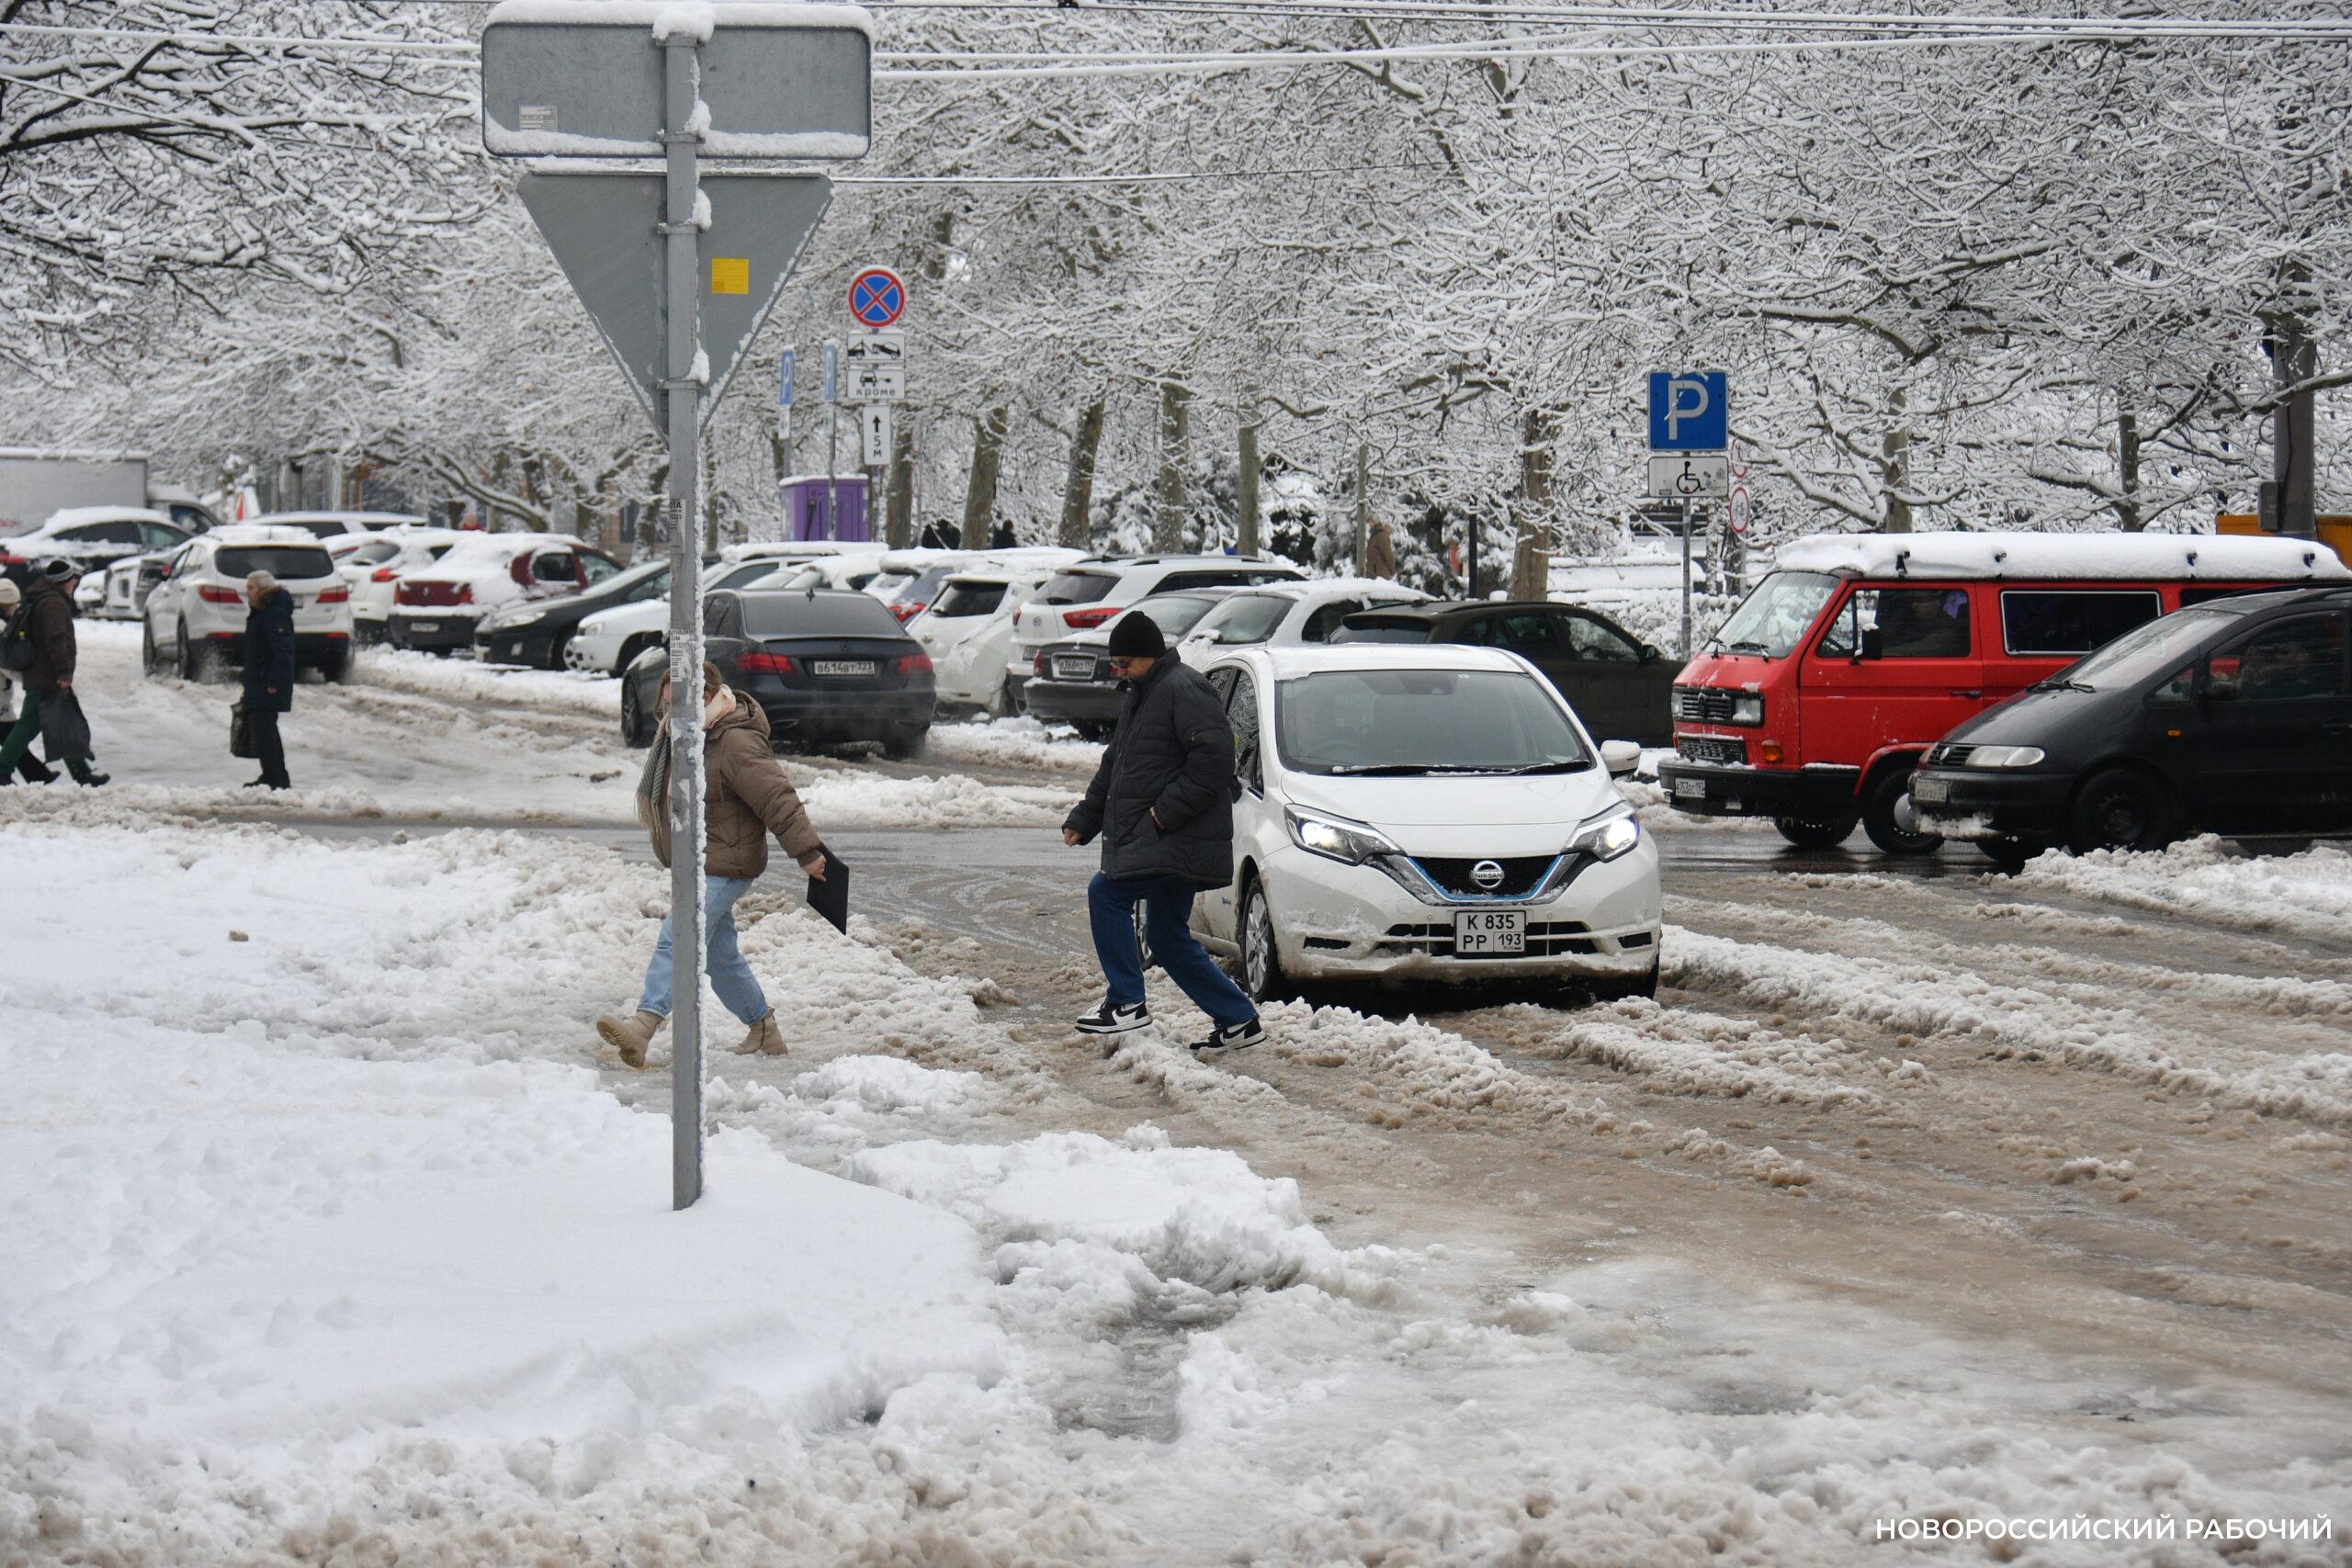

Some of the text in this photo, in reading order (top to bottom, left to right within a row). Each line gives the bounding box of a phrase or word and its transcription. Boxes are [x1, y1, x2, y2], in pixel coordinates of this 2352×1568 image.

[856, 389, 896, 398] кроме
[1668, 379, 1709, 441] P
[874, 435, 881, 446] 5
[1467, 914, 1515, 930] К 835
[1463, 933, 1521, 950] РР 193
